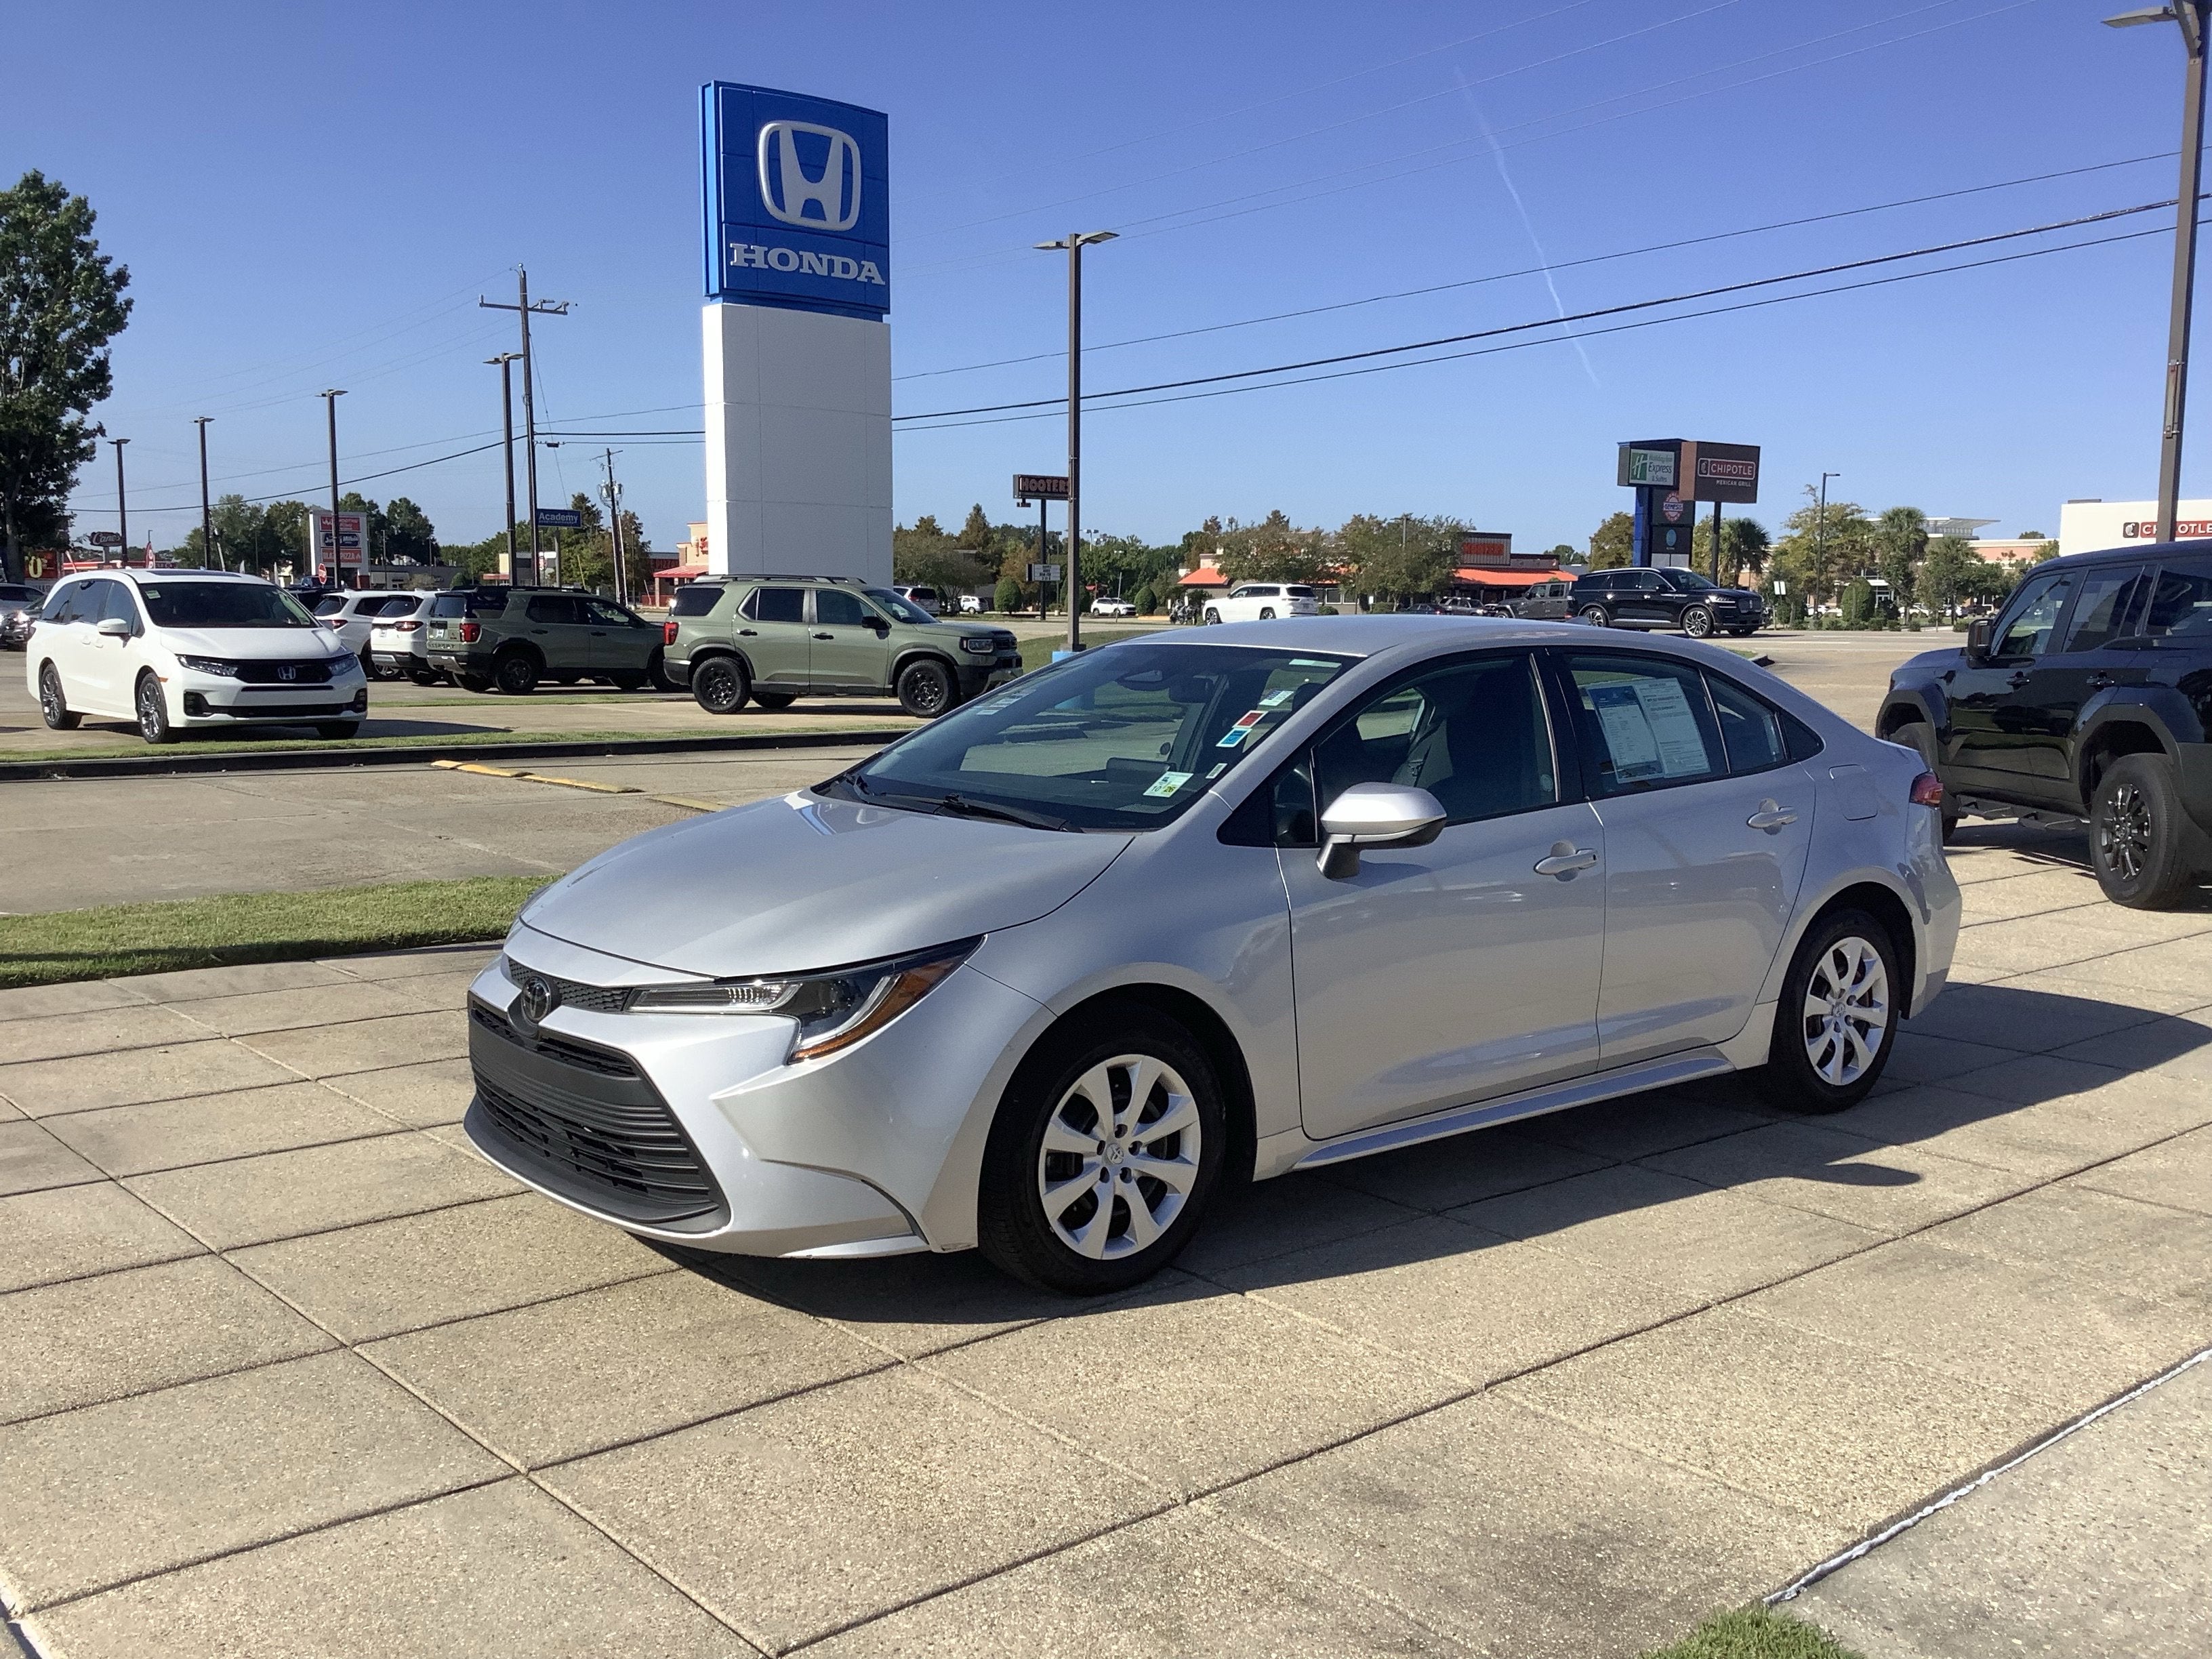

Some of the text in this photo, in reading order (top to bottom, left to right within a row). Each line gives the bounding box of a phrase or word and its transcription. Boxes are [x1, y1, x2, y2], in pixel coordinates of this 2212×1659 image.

[729, 243, 886, 285] HONDA
[1648, 462, 1672, 474] Express
[1711, 463, 1753, 476] CHIPOTLE
[1020, 477, 1070, 493] HOOTER
[538, 512, 578, 524] Academy
[2142, 523, 2212, 535] COTLE
